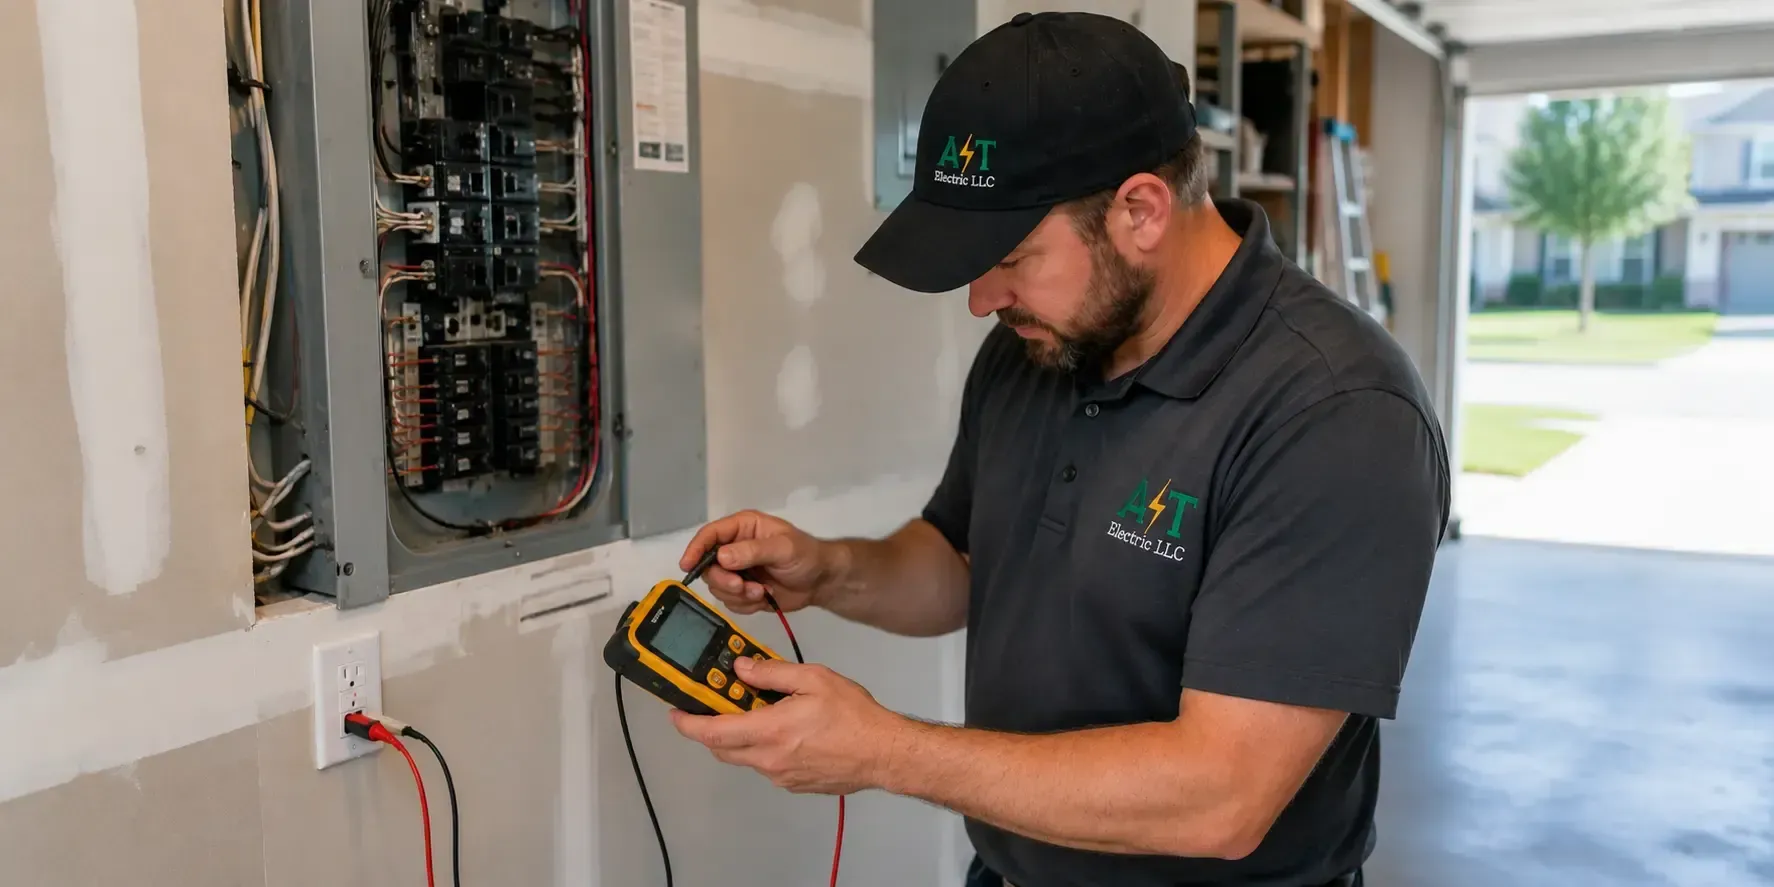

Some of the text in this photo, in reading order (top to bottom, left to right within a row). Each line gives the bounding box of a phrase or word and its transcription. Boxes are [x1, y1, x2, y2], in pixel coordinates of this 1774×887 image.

[934, 170, 995, 188] Electric LLC
[1107, 520, 1186, 562] Electric LLC
